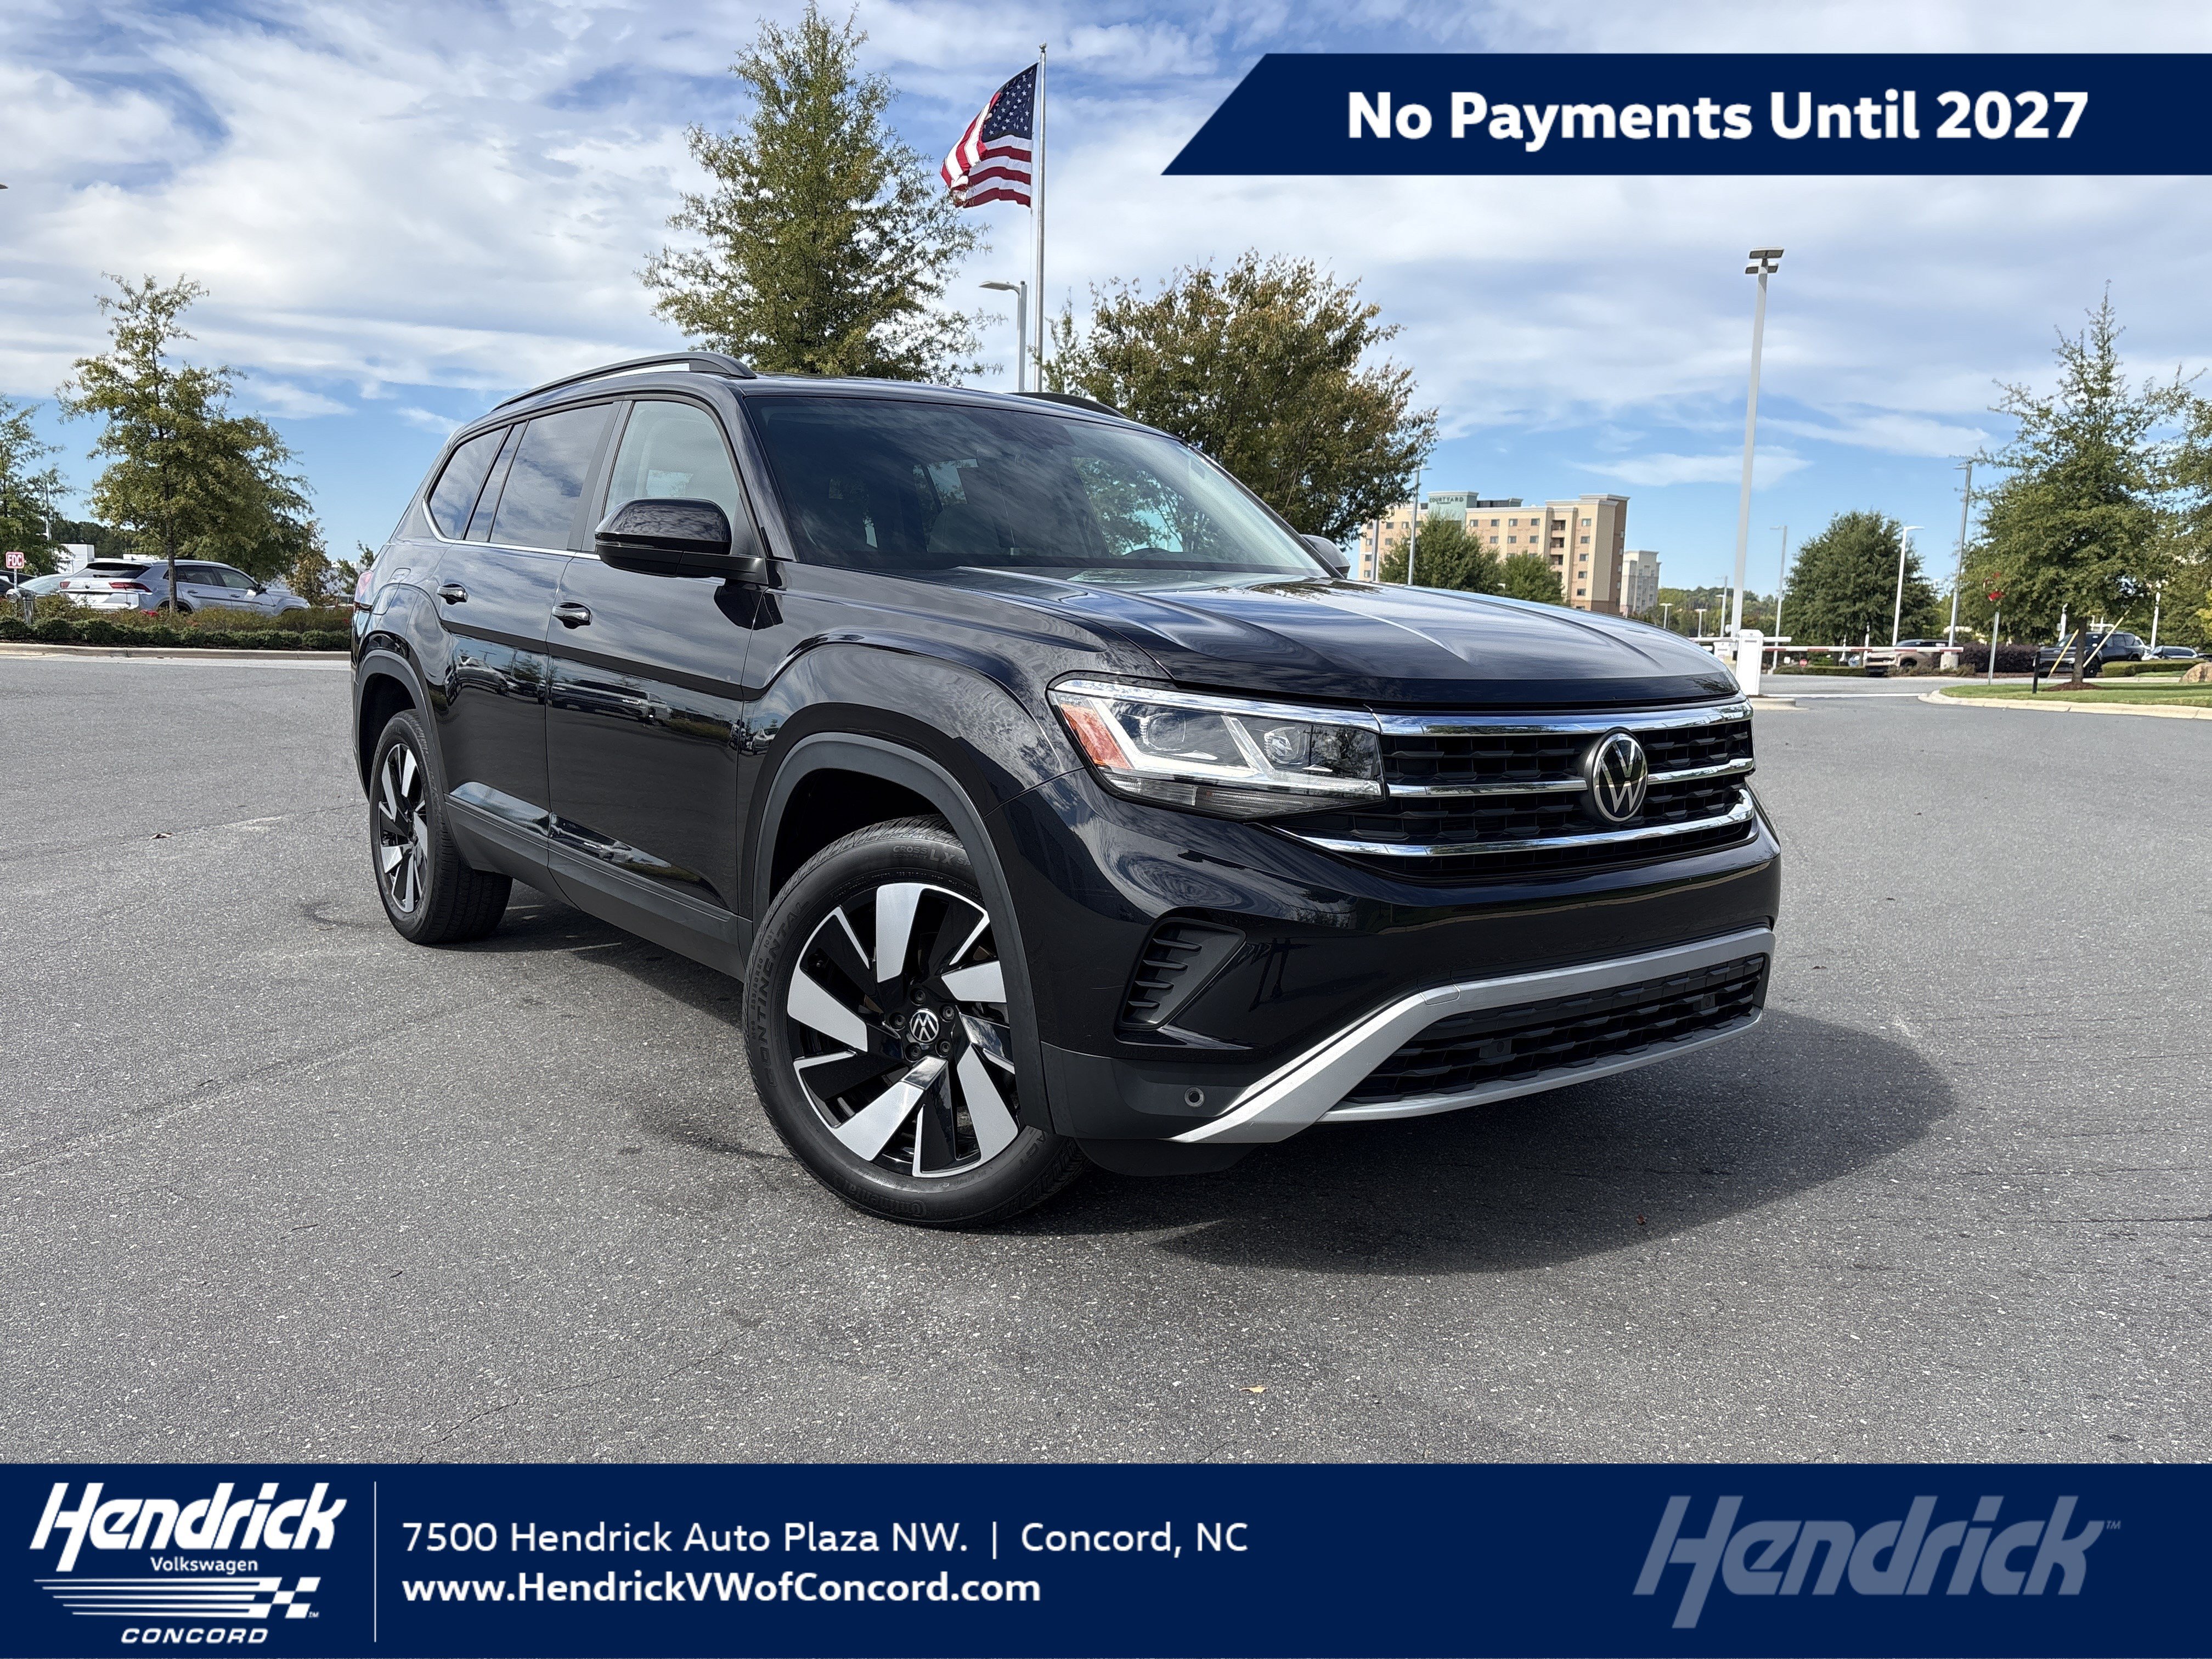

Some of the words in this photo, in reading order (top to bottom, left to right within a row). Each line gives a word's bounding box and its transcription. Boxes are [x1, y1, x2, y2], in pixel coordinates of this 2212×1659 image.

[8, 554, 22, 566] FDC
[1594, 734, 1647, 821] VW
[893, 845, 928, 854] CROSS
[929, 849, 955, 866] LX
[757, 900, 810, 1087] CONTINENTAL
